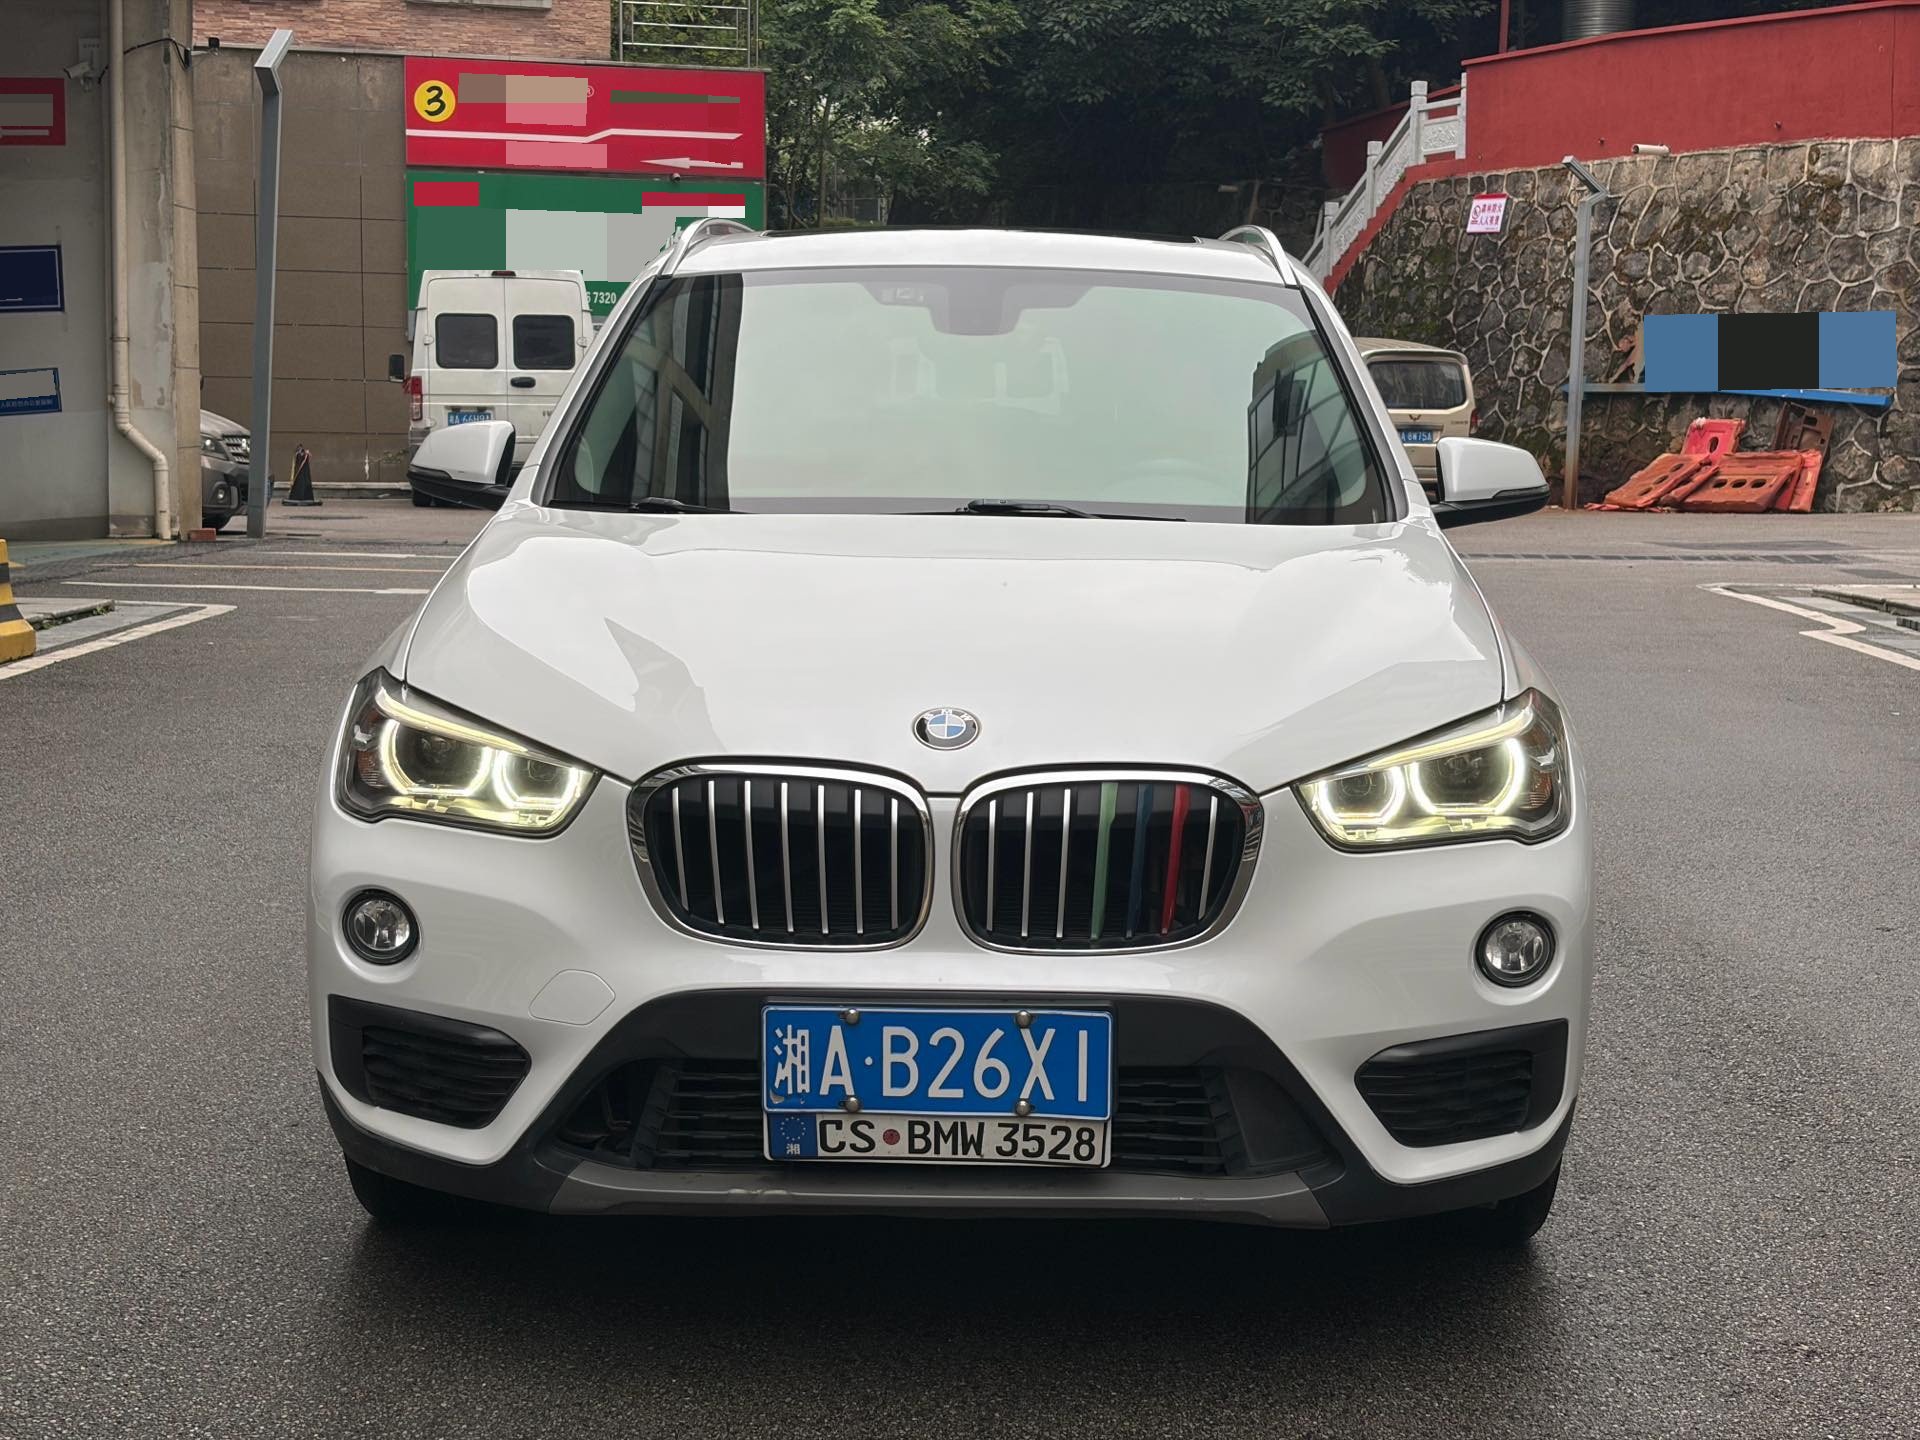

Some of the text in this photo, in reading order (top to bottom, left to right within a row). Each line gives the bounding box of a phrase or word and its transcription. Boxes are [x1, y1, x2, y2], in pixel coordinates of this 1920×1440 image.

[424, 85, 446, 116] 3
[592, 291, 617, 304] 7320
[818, 1119, 1096, 1162] CS BMW 3528
